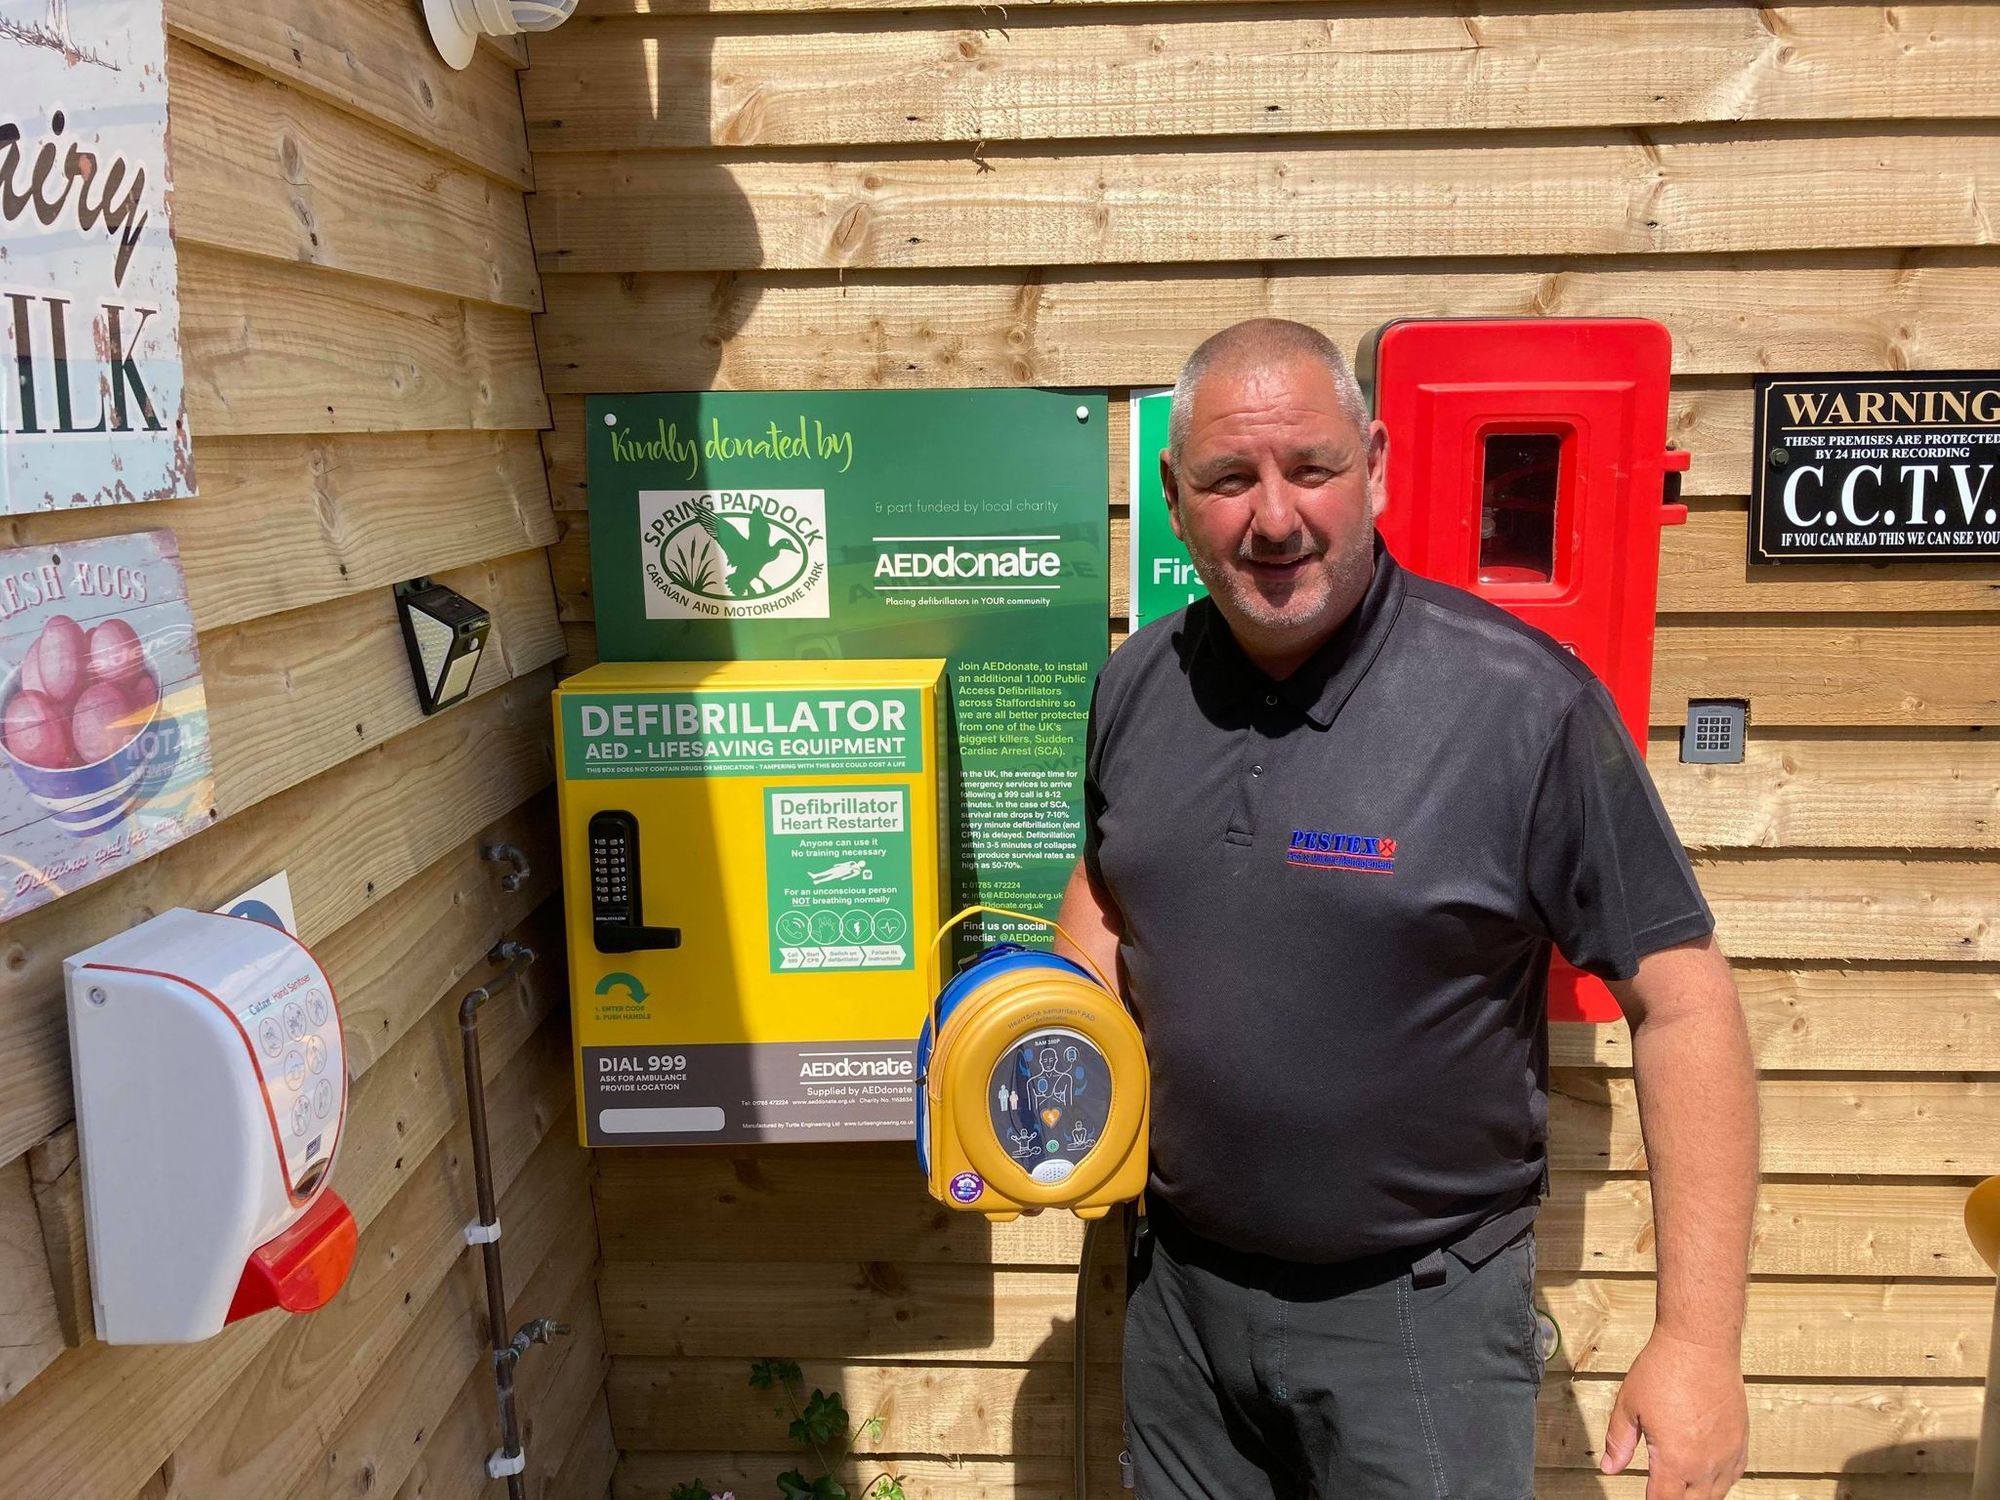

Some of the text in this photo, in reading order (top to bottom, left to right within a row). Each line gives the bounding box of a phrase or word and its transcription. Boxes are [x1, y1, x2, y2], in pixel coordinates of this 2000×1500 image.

[0, 293, 167, 434] ILK
[1783, 390, 2000, 424] WARNING
[1784, 434, 2000, 446] THESE PREMISES ARE PROTECTED
[611, 416, 852, 480] Kindly donated by
[1816, 448, 1970, 459] BY 24 HOUR RECORDING
[1783, 464, 1997, 527] C.C.T.V.
[887, 502, 912, 515] part
[917, 500, 959, 513] funded
[964, 500, 978, 514] by
[983, 499, 1012, 512] local
[1017, 499, 1058, 513] charity
[644, 493, 824, 547] SPRING PADDOCK
[1781, 531, 2000, 546] IF YOU CAN READ THIS WE CAN SEE YOU
[874, 546, 1060, 577] AEDdonate
[646, 563, 689, 606] CARAVAN
[692, 601, 719, 615] AND
[724, 590, 805, 617] MOTORHOME
[806, 562, 824, 591] PARK
[886, 597, 916, 607] Placing
[918, 597, 969, 605] defibrillators
[1007, 598, 1050, 607] community
[958, 662, 1088, 672] Join AEDdonate, to install
[974, 675, 1022, 683] additional
[1026, 675, 1051, 684] 1,000
[1055, 675, 1086, 683] Public
[998, 687, 1062, 695] Defibrillators
[996, 699, 1060, 707] Staffordshire
[581, 700, 906, 736] DEFIBRILLATOR
[1009, 711, 1038, 719] better
[1041, 711, 1088, 721] protected
[960, 723, 982, 731] from
[1007, 723, 1017, 731] of
[1019, 723, 1035, 731] the
[1039, 723, 1061, 731] UK's
[960, 735, 1073, 744] biggest killers, Sudden
[585, 743, 628, 759] AED
[648, 740, 773, 758] LIFESAVING
[781, 737, 905, 756] EQUIPMENT
[960, 747, 1065, 757] Cardiac Arrest (SCA).
[961, 791, 995, 799] following
[781, 798, 898, 815] Defibrillator
[782, 816, 897, 830] Heart Restarter
[800, 840, 833, 848] Anyone
[1290, 831, 1379, 855] PESTEX
[806, 849, 839, 857] training
[869, 887, 897, 895] person
[813, 897, 851, 905] breathing
[855, 896, 890, 904] normally
[963, 922, 984, 930] Find
[1017, 922, 1047, 930] social
[600, 1055, 686, 1071] DIAL 999
[800, 1057, 912, 1078] AEDdonate
[807, 1088, 847, 1097] Supplied
[849, 1088, 859, 1096] by
